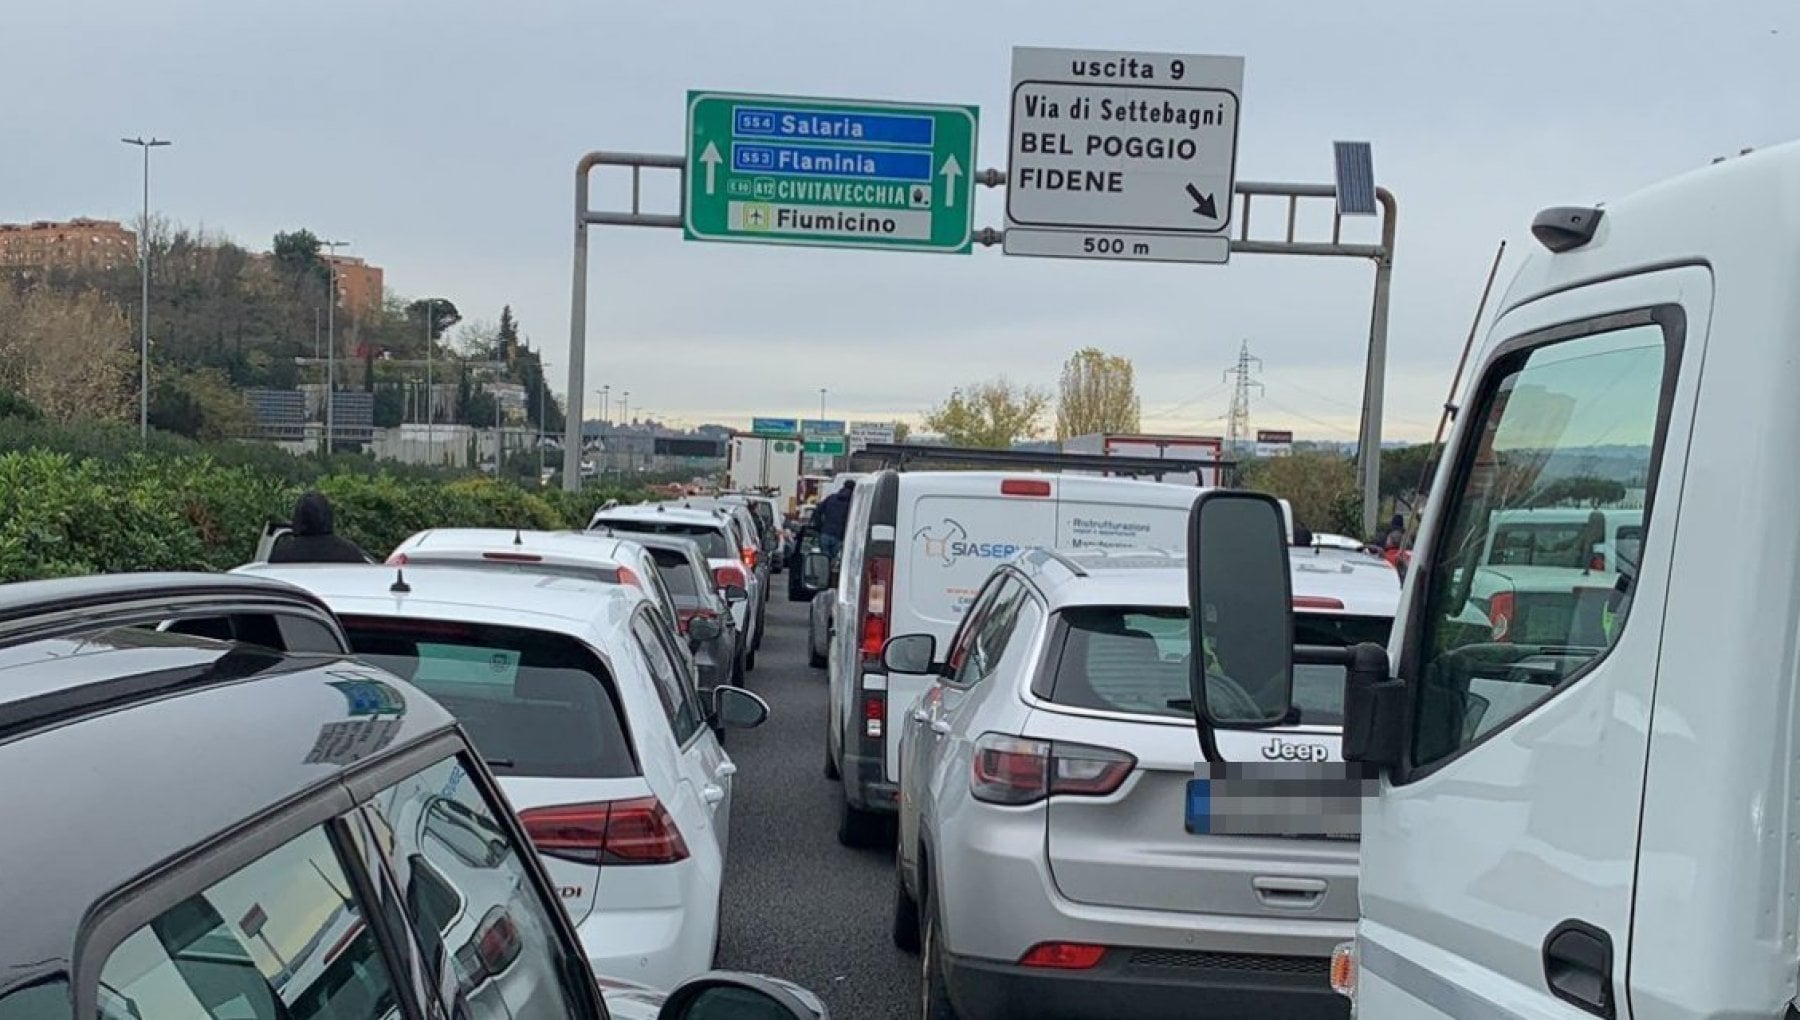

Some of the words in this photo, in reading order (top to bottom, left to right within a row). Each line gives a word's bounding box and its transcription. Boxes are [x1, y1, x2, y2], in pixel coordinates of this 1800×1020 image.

[1072, 58, 1154, 79] uscita
[1170, 60, 1185, 80] 9
[1024, 94, 1060, 119] Via
[1069, 97, 1090, 120] di
[1101, 98, 1224, 130] Settebagni
[781, 115, 864, 137] Salaria
[1020, 132, 1074, 155] BEL
[1086, 134, 1197, 160] POGGIO
[778, 150, 876, 174] Flaminia
[1019, 168, 1124, 192] FIDENE
[778, 180, 905, 205] CIVITAVECCHIA
[777, 208, 896, 233] Fiumicino
[1083, 237, 1125, 254] 500
[1133, 242, 1149, 256] m
[1262, 738, 1328, 762] Jeep
